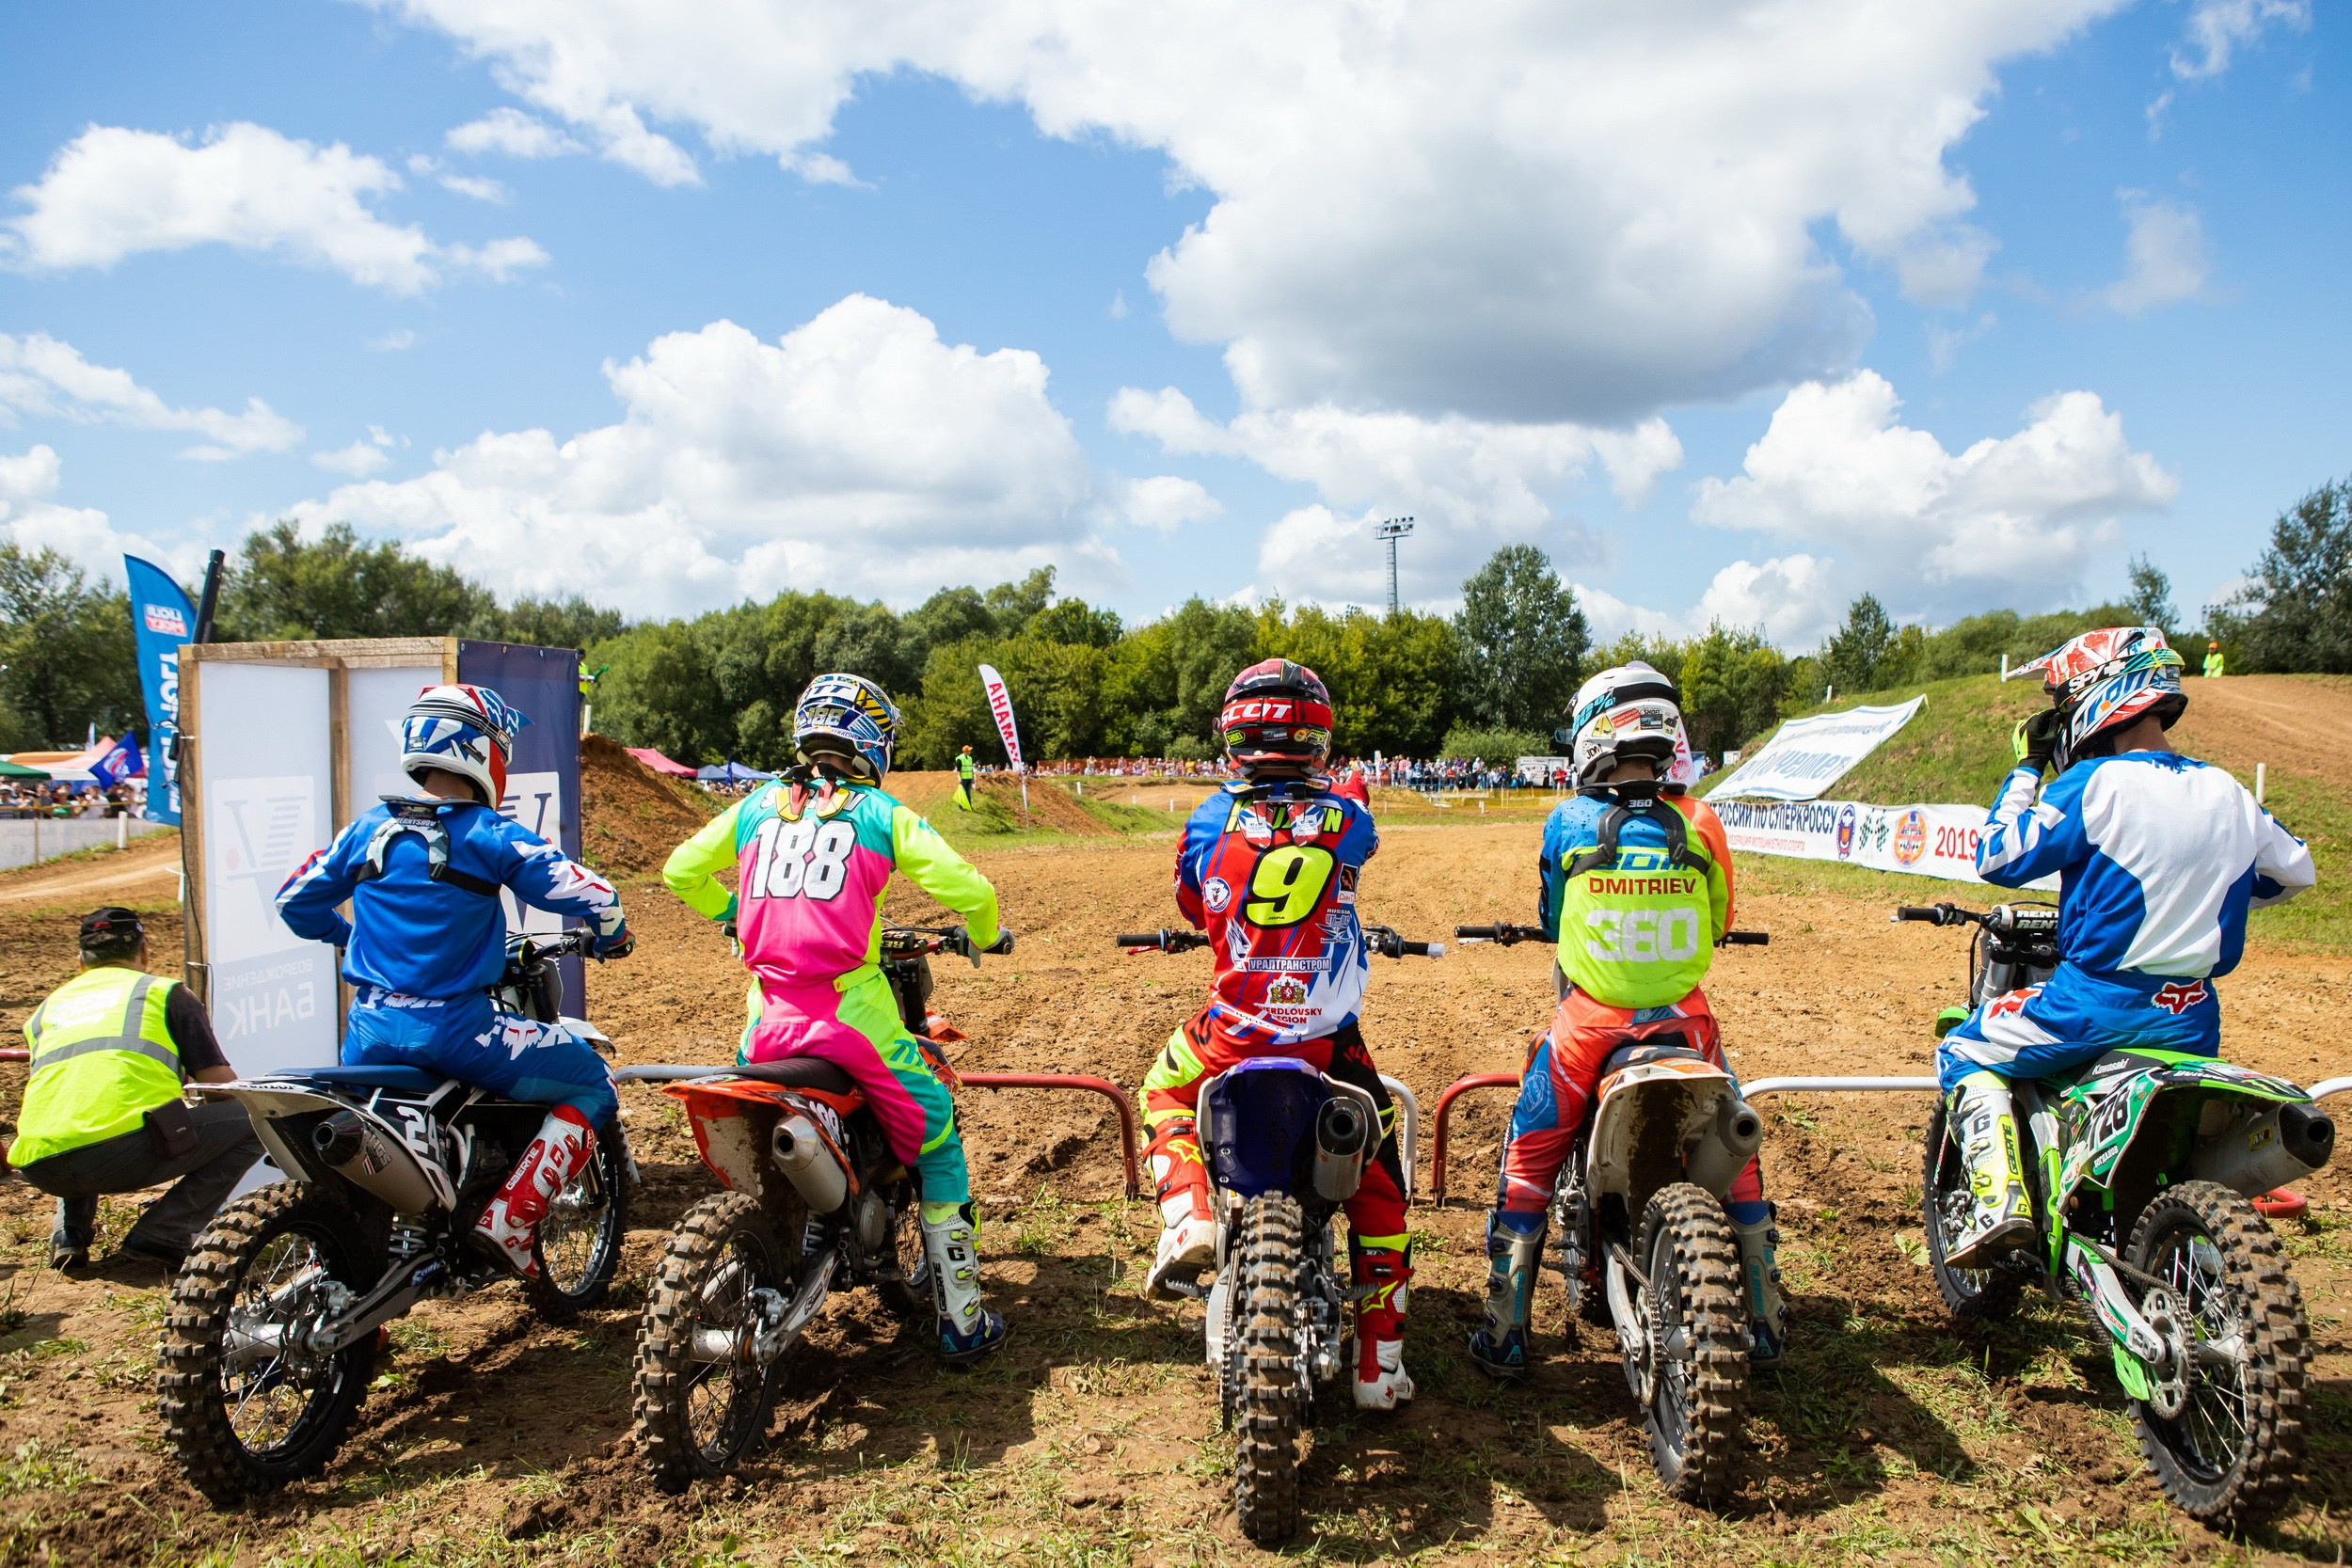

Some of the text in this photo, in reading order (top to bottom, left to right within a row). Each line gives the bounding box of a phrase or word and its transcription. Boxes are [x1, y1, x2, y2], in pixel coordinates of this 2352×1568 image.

[2069, 663, 2106, 693] SPY
[1629, 799, 1652, 808] 360
[1755, 803, 1768, 830] ПО
[1769, 803, 1839, 834] СУПЕРКРОССУ
[1934, 825, 1978, 861] 2019
[751, 816, 858, 901] 188
[1244, 844, 1337, 928] 9
[1589, 878, 1696, 895] DMITRIEV
[1586, 908, 1698, 963] 360
[1249, 958, 1330, 971] УРАЛТРАНСТРОМ
[2092, 1057, 2130, 1076] Kawasaki
[2103, 1308, 2126, 1334] BRAKING
